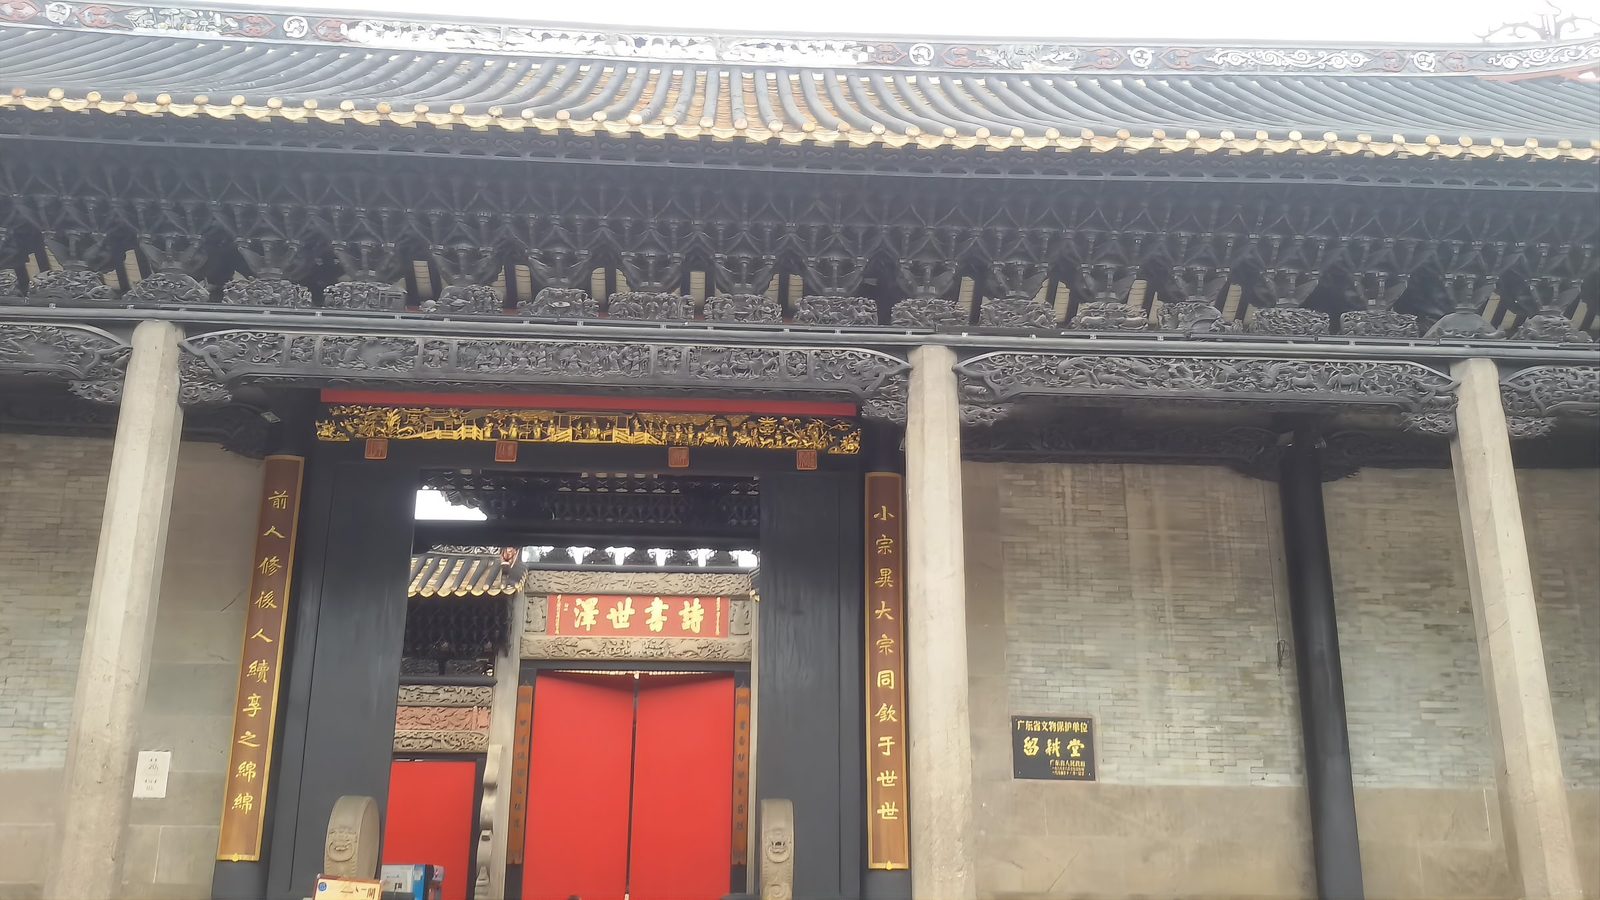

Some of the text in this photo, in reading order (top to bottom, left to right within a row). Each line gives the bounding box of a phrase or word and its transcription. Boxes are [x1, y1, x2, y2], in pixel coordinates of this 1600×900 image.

[1017, 720, 1088, 733] 广东省文物保护单位
